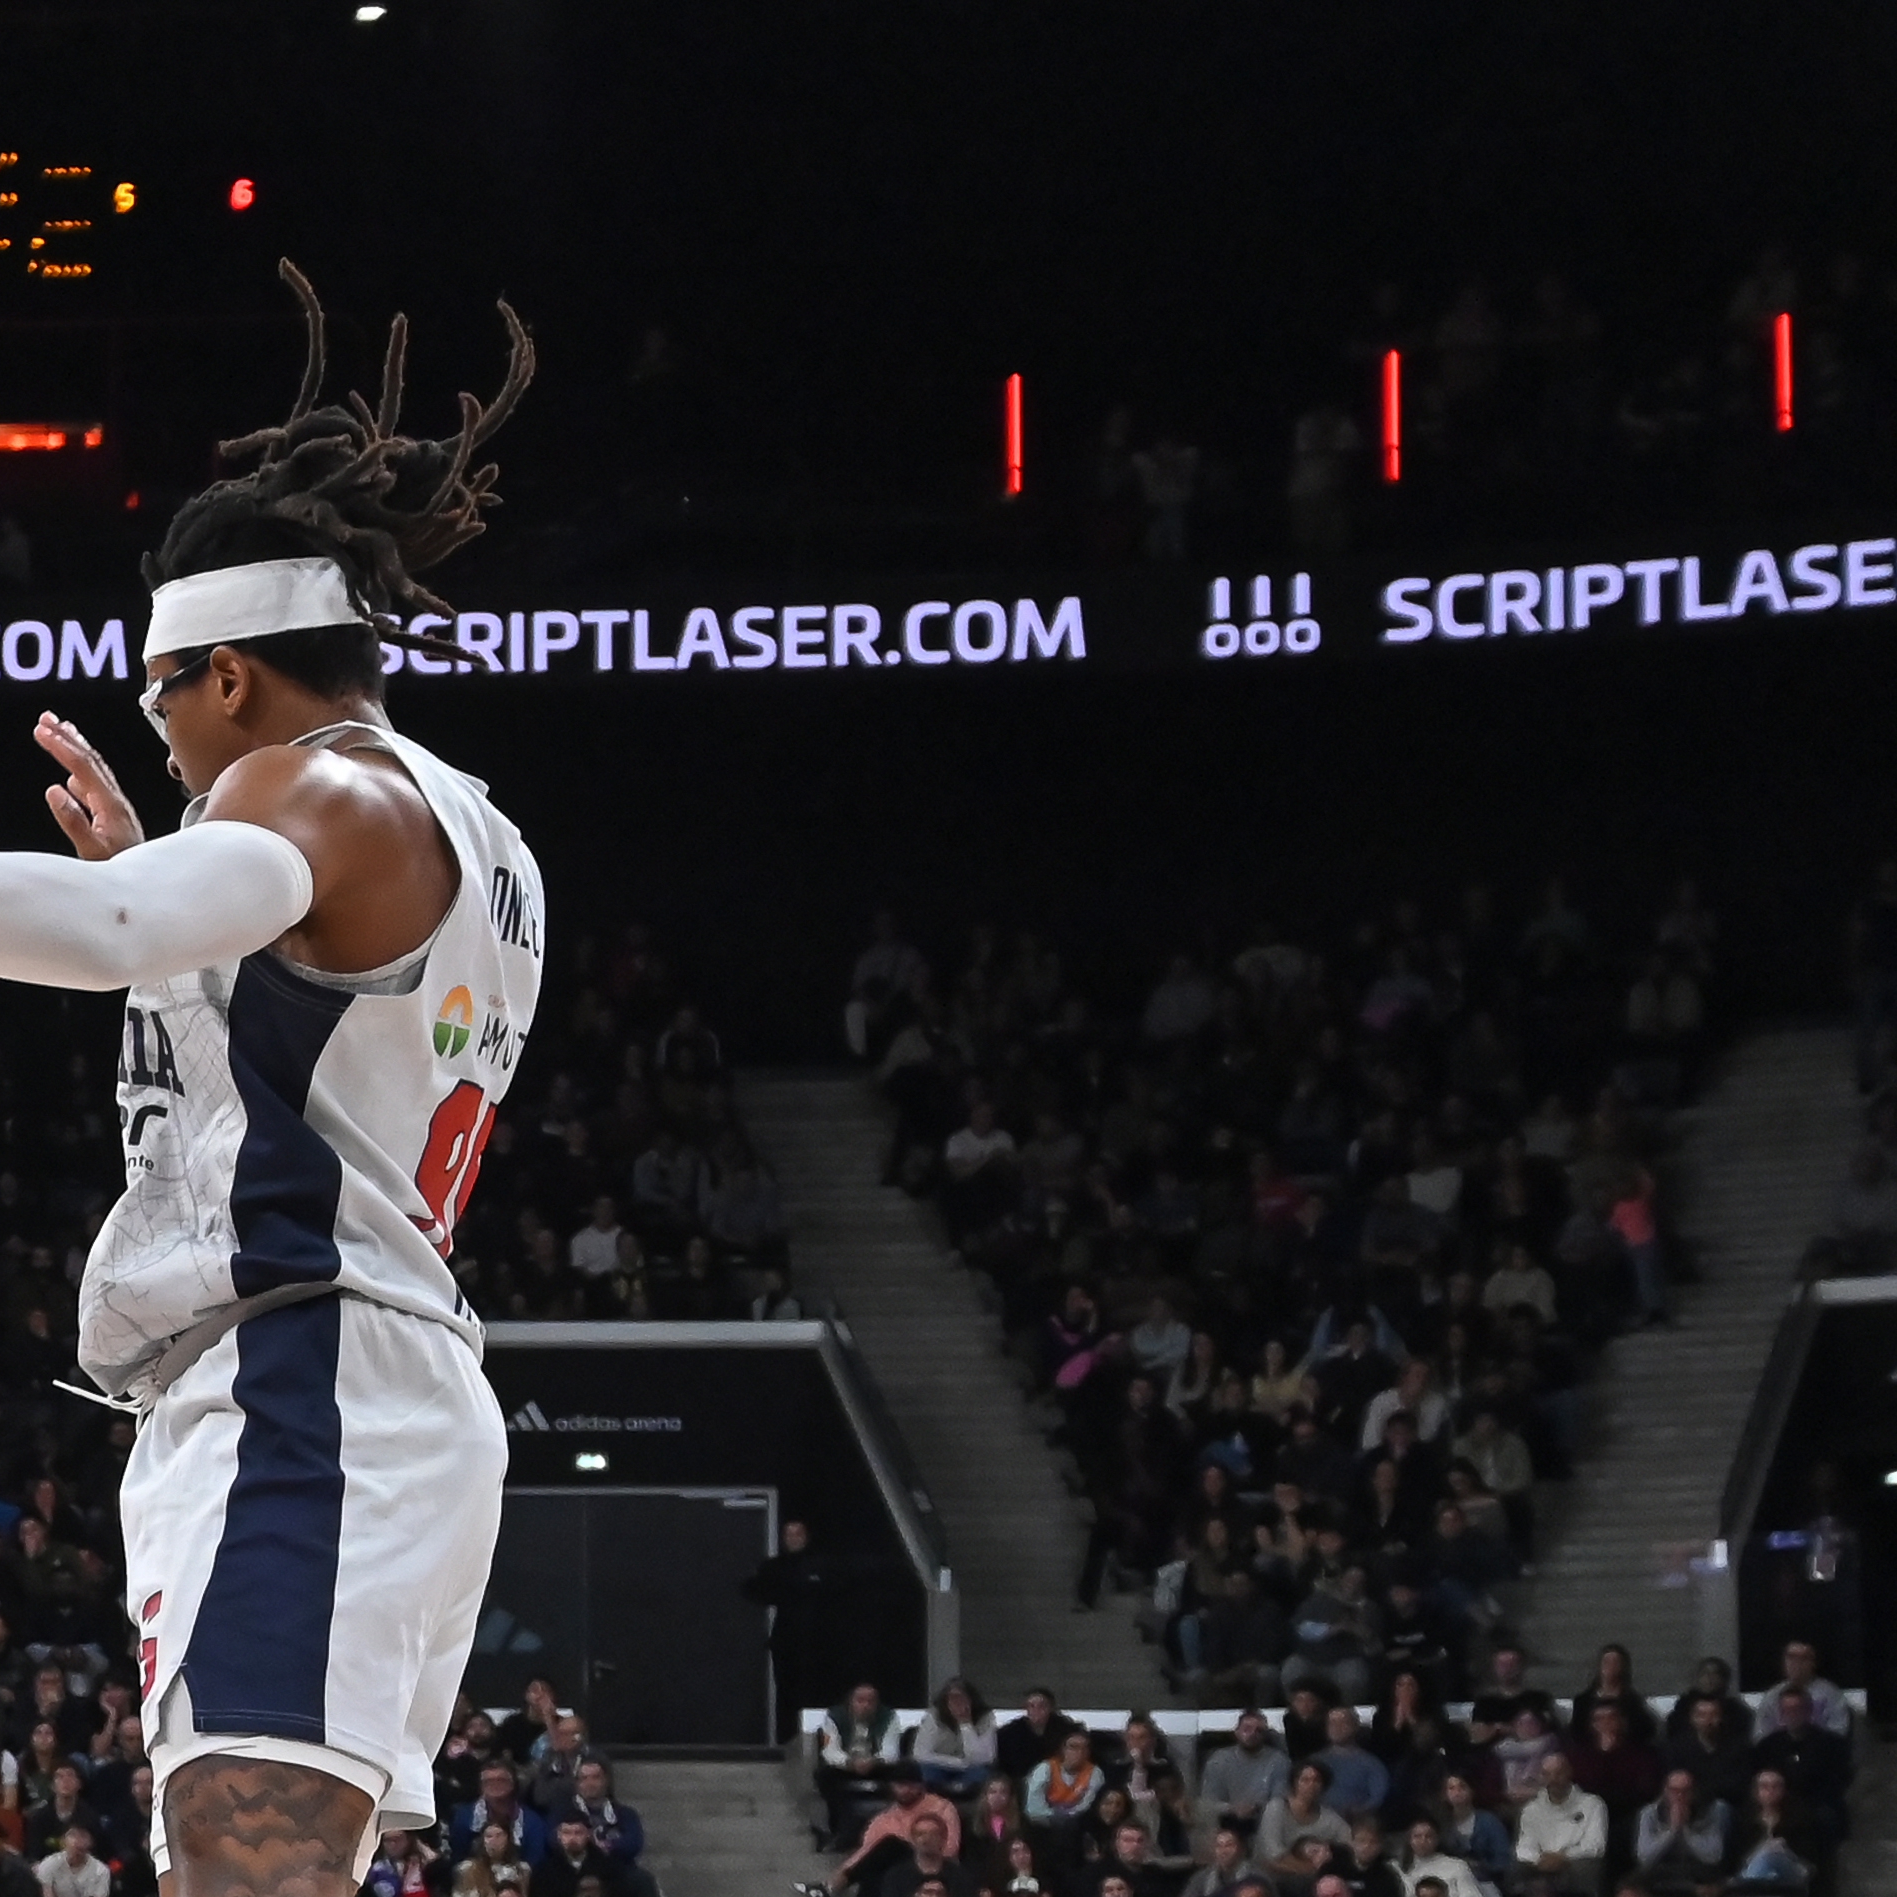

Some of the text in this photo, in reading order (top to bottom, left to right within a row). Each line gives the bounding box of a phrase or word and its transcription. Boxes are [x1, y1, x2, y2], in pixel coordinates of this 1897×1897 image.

[230, 177, 255, 211] 6
[554, 1415, 683, 1432] adidas arena
